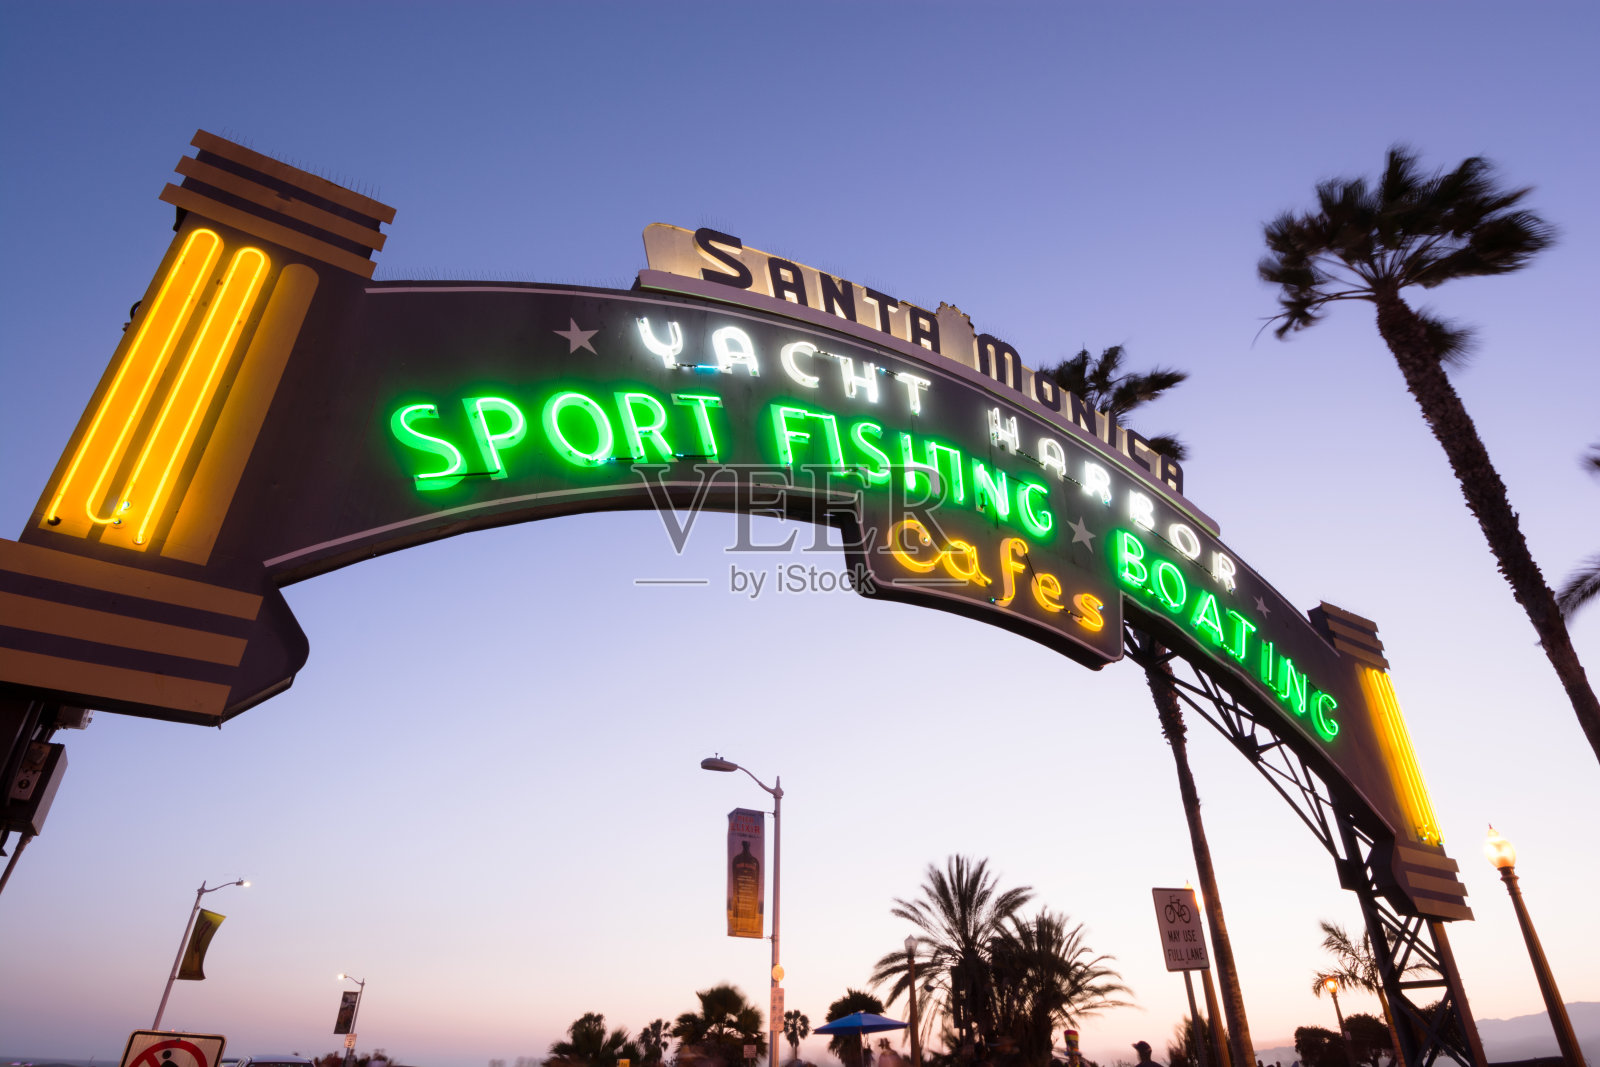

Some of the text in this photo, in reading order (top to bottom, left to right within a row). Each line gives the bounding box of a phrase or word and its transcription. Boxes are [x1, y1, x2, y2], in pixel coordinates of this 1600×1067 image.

[635, 315, 1237, 595] YACHT HARBOR
[694, 226, 1184, 497] SANTA MONICA
[391, 391, 1339, 742] SPORT FISHING BOATING
[886, 518, 1105, 632] Cafes
[1167, 929, 1197, 942] MAY USE
[1167, 947, 1205, 961] FULL LANE
